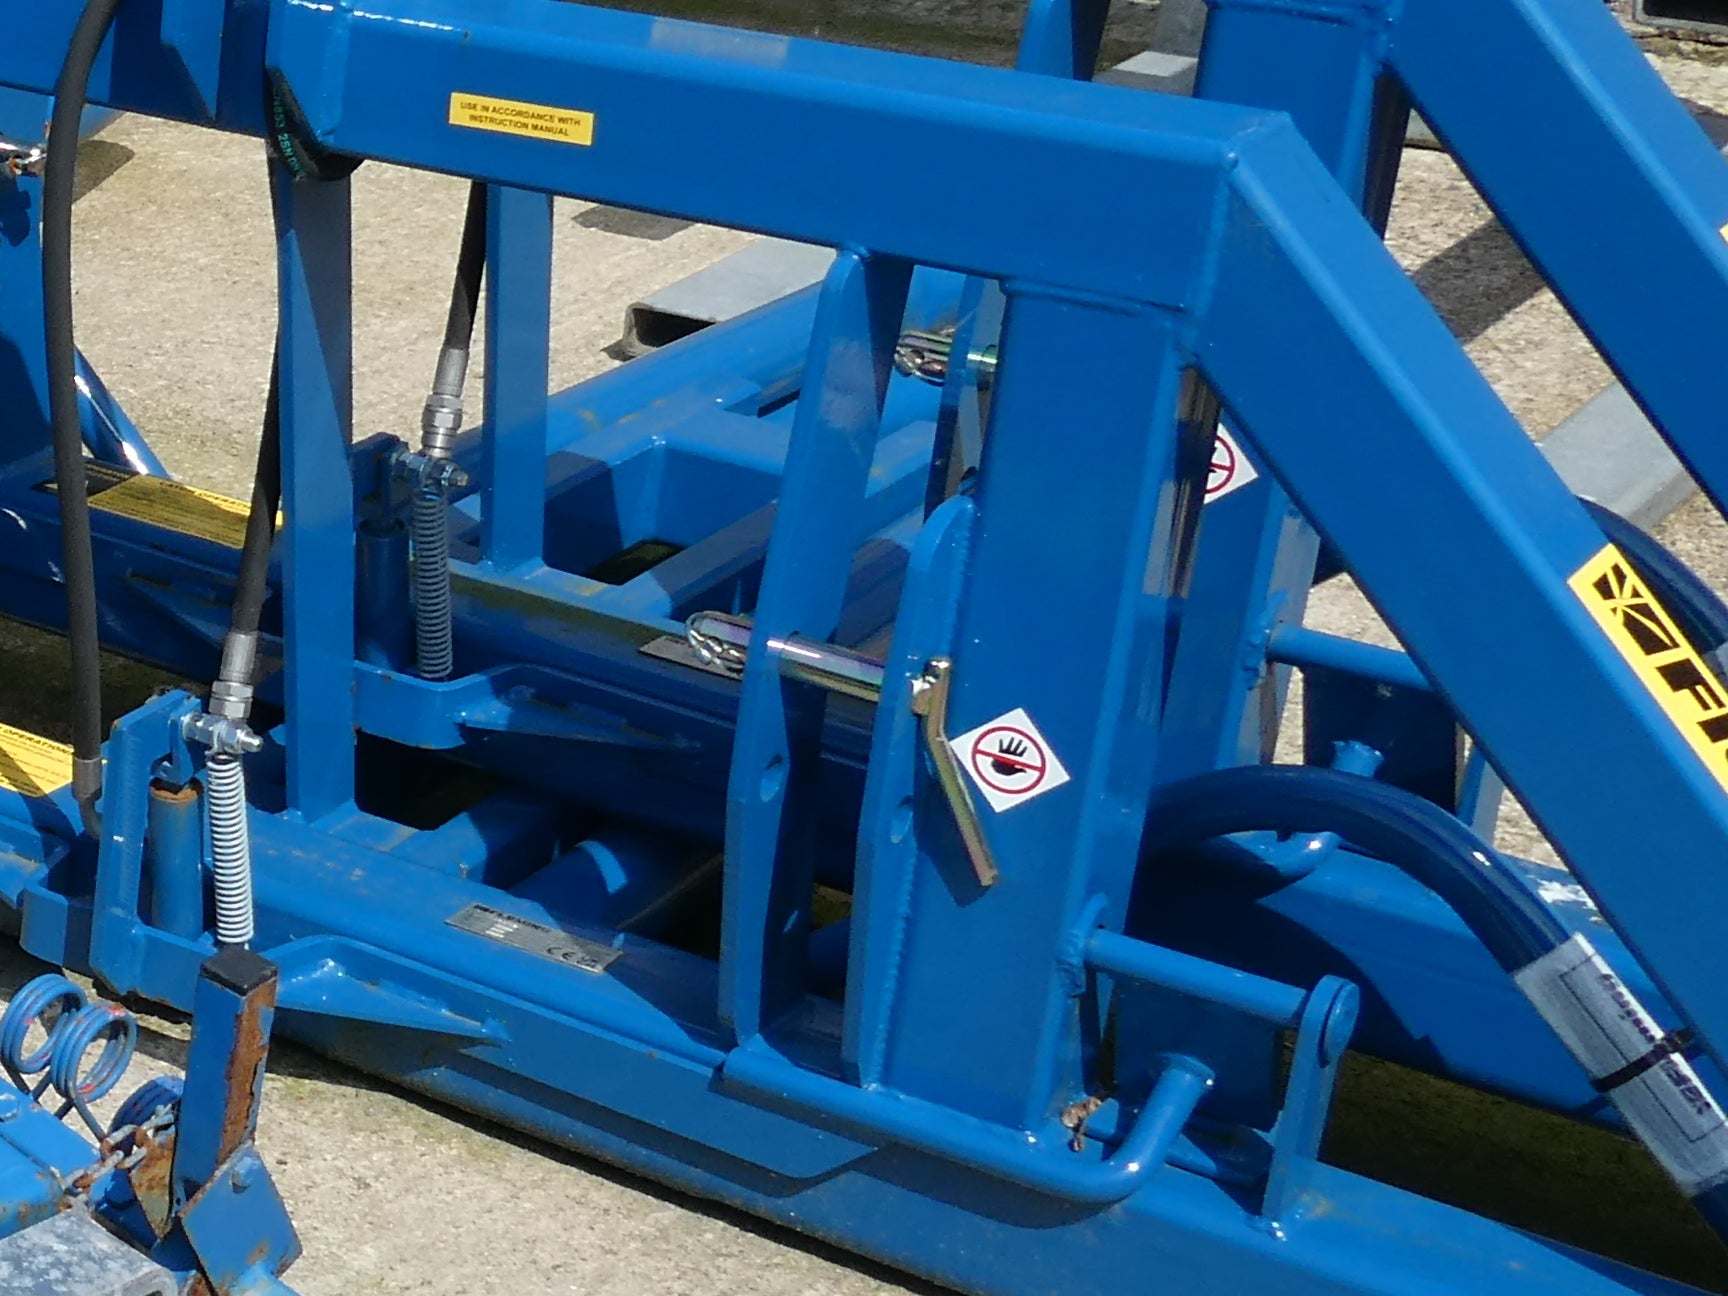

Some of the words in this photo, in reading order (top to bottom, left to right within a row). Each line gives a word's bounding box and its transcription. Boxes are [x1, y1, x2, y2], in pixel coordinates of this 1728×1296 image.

[460, 102, 478, 112] USE
[491, 106, 556, 124] ACCORDANCE
[556, 115, 581, 126] WITH
[469, 114, 529, 131] INSTRUCTION
[531, 124, 569, 136] MANUAL
